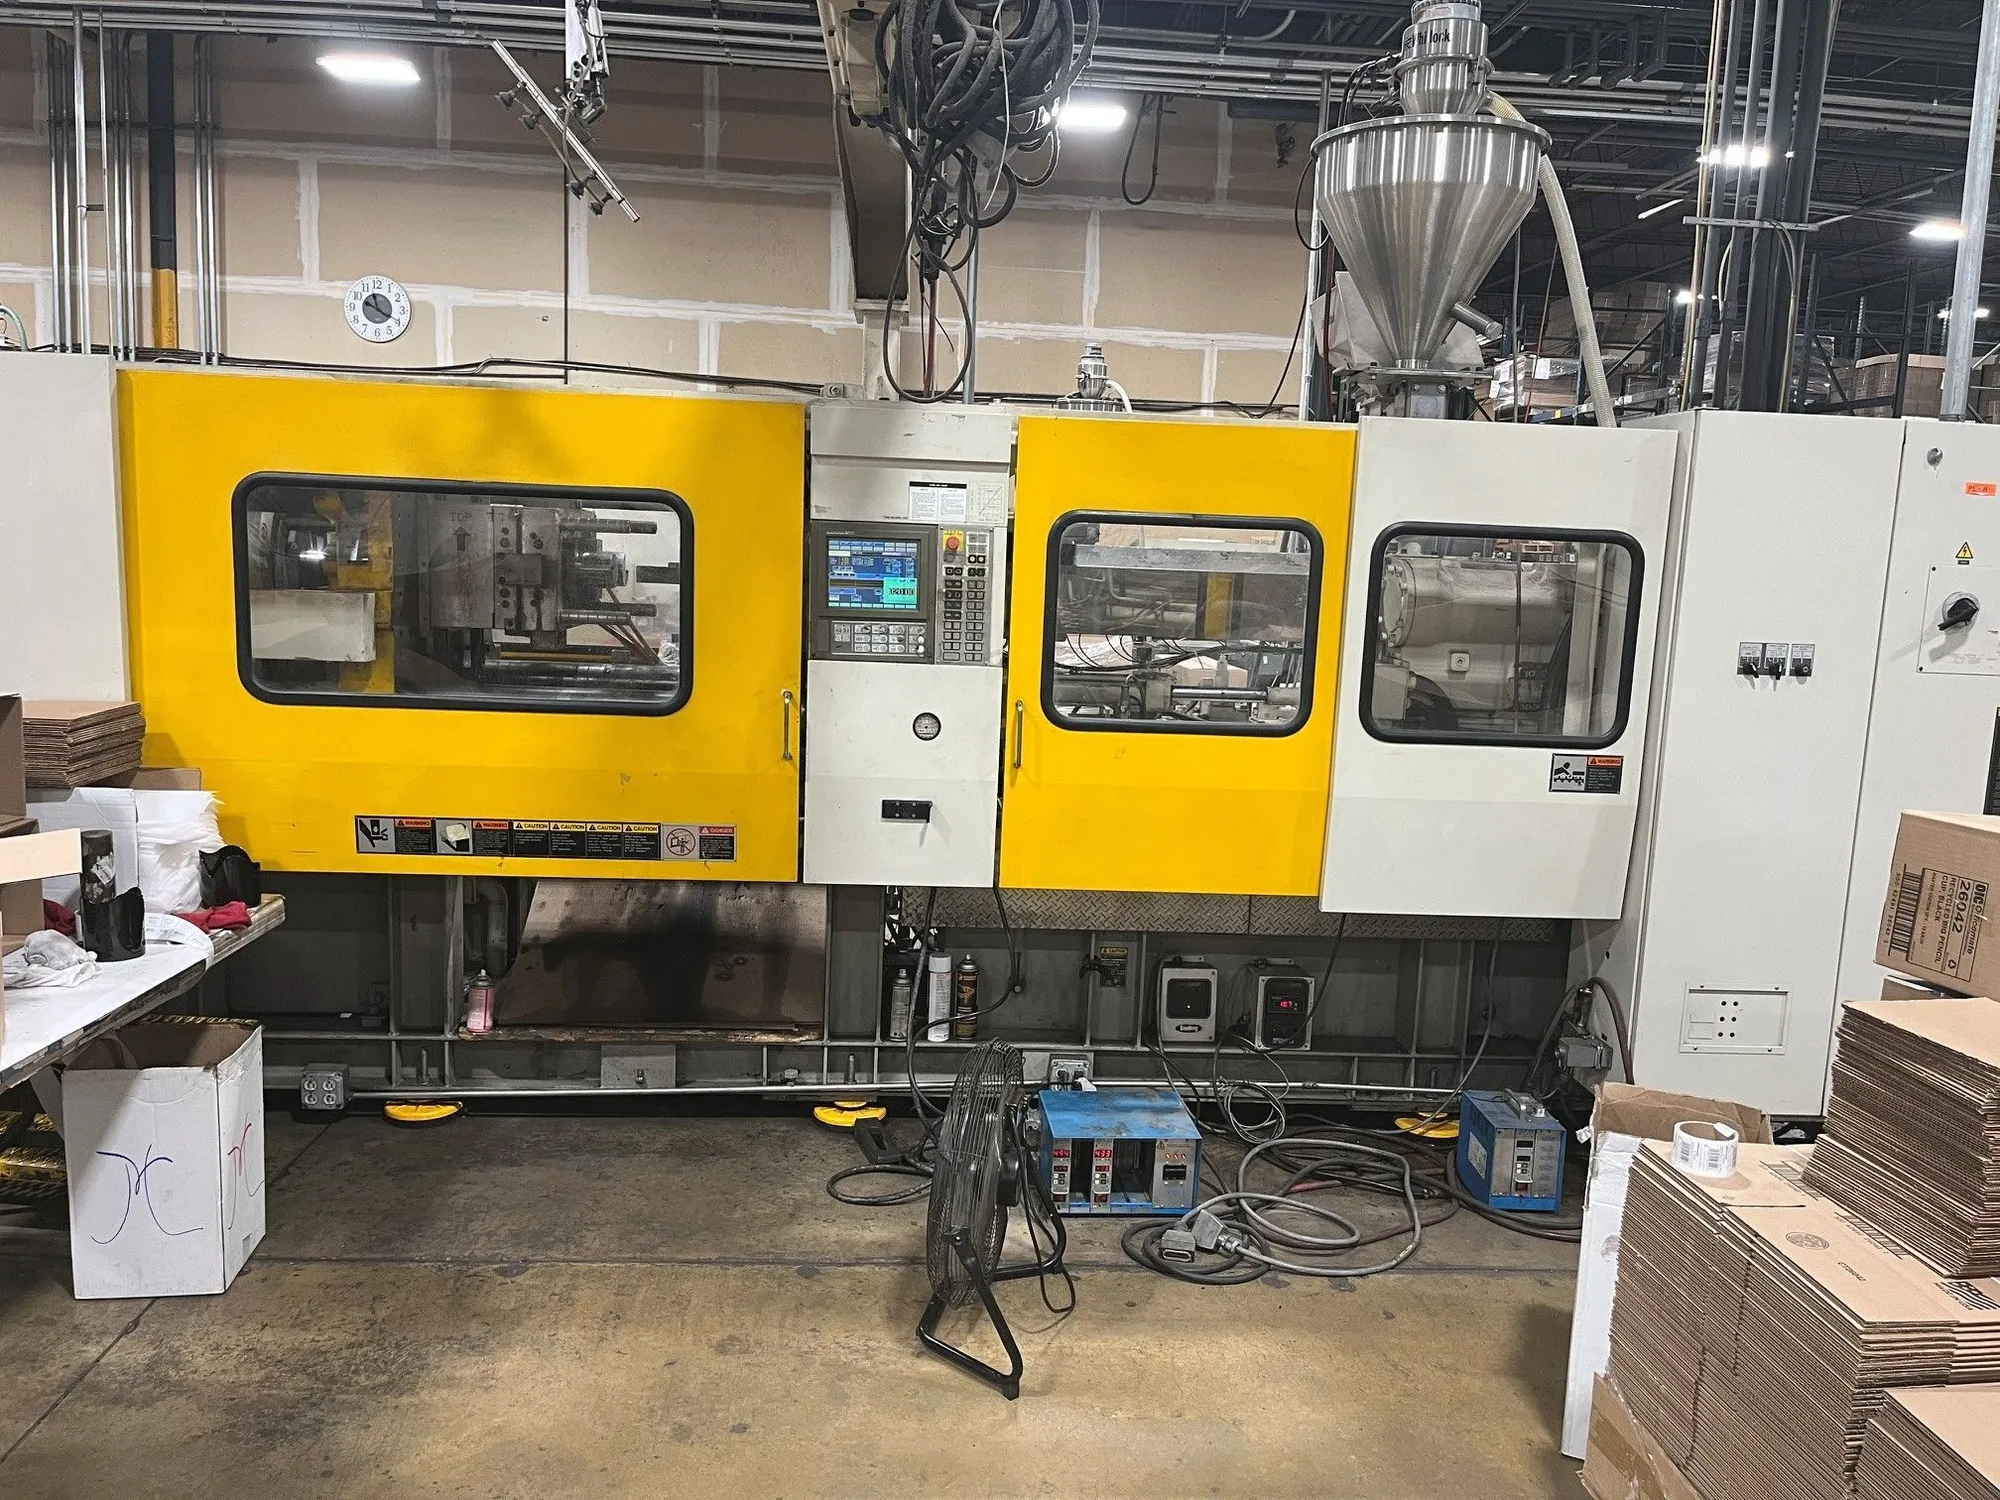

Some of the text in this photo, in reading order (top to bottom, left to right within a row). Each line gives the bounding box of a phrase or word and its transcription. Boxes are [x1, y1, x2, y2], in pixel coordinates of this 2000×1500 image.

[362, 283, 369, 292] 11
[372, 280, 382, 289] 12
[388, 284, 391, 293] 1
[353, 291, 362, 300] 10
[395, 293, 401, 302] 2
[349, 303, 355, 312] 9
[399, 306, 406, 315] 3
[353, 315, 359, 324] 8
[362, 324, 368, 333] 7
[374, 328, 380, 337] 6
[386, 326, 393, 335] 5
[405, 818, 430, 826] WARNING
[1934, 874, 1948, 921] CUP, BLACK
[1943, 877, 1956, 918] RECYCLED
[1973, 883, 1985, 904] OIC
[1951, 879, 1970, 933] 26042
[1934, 935, 1944, 963] PENCIL
